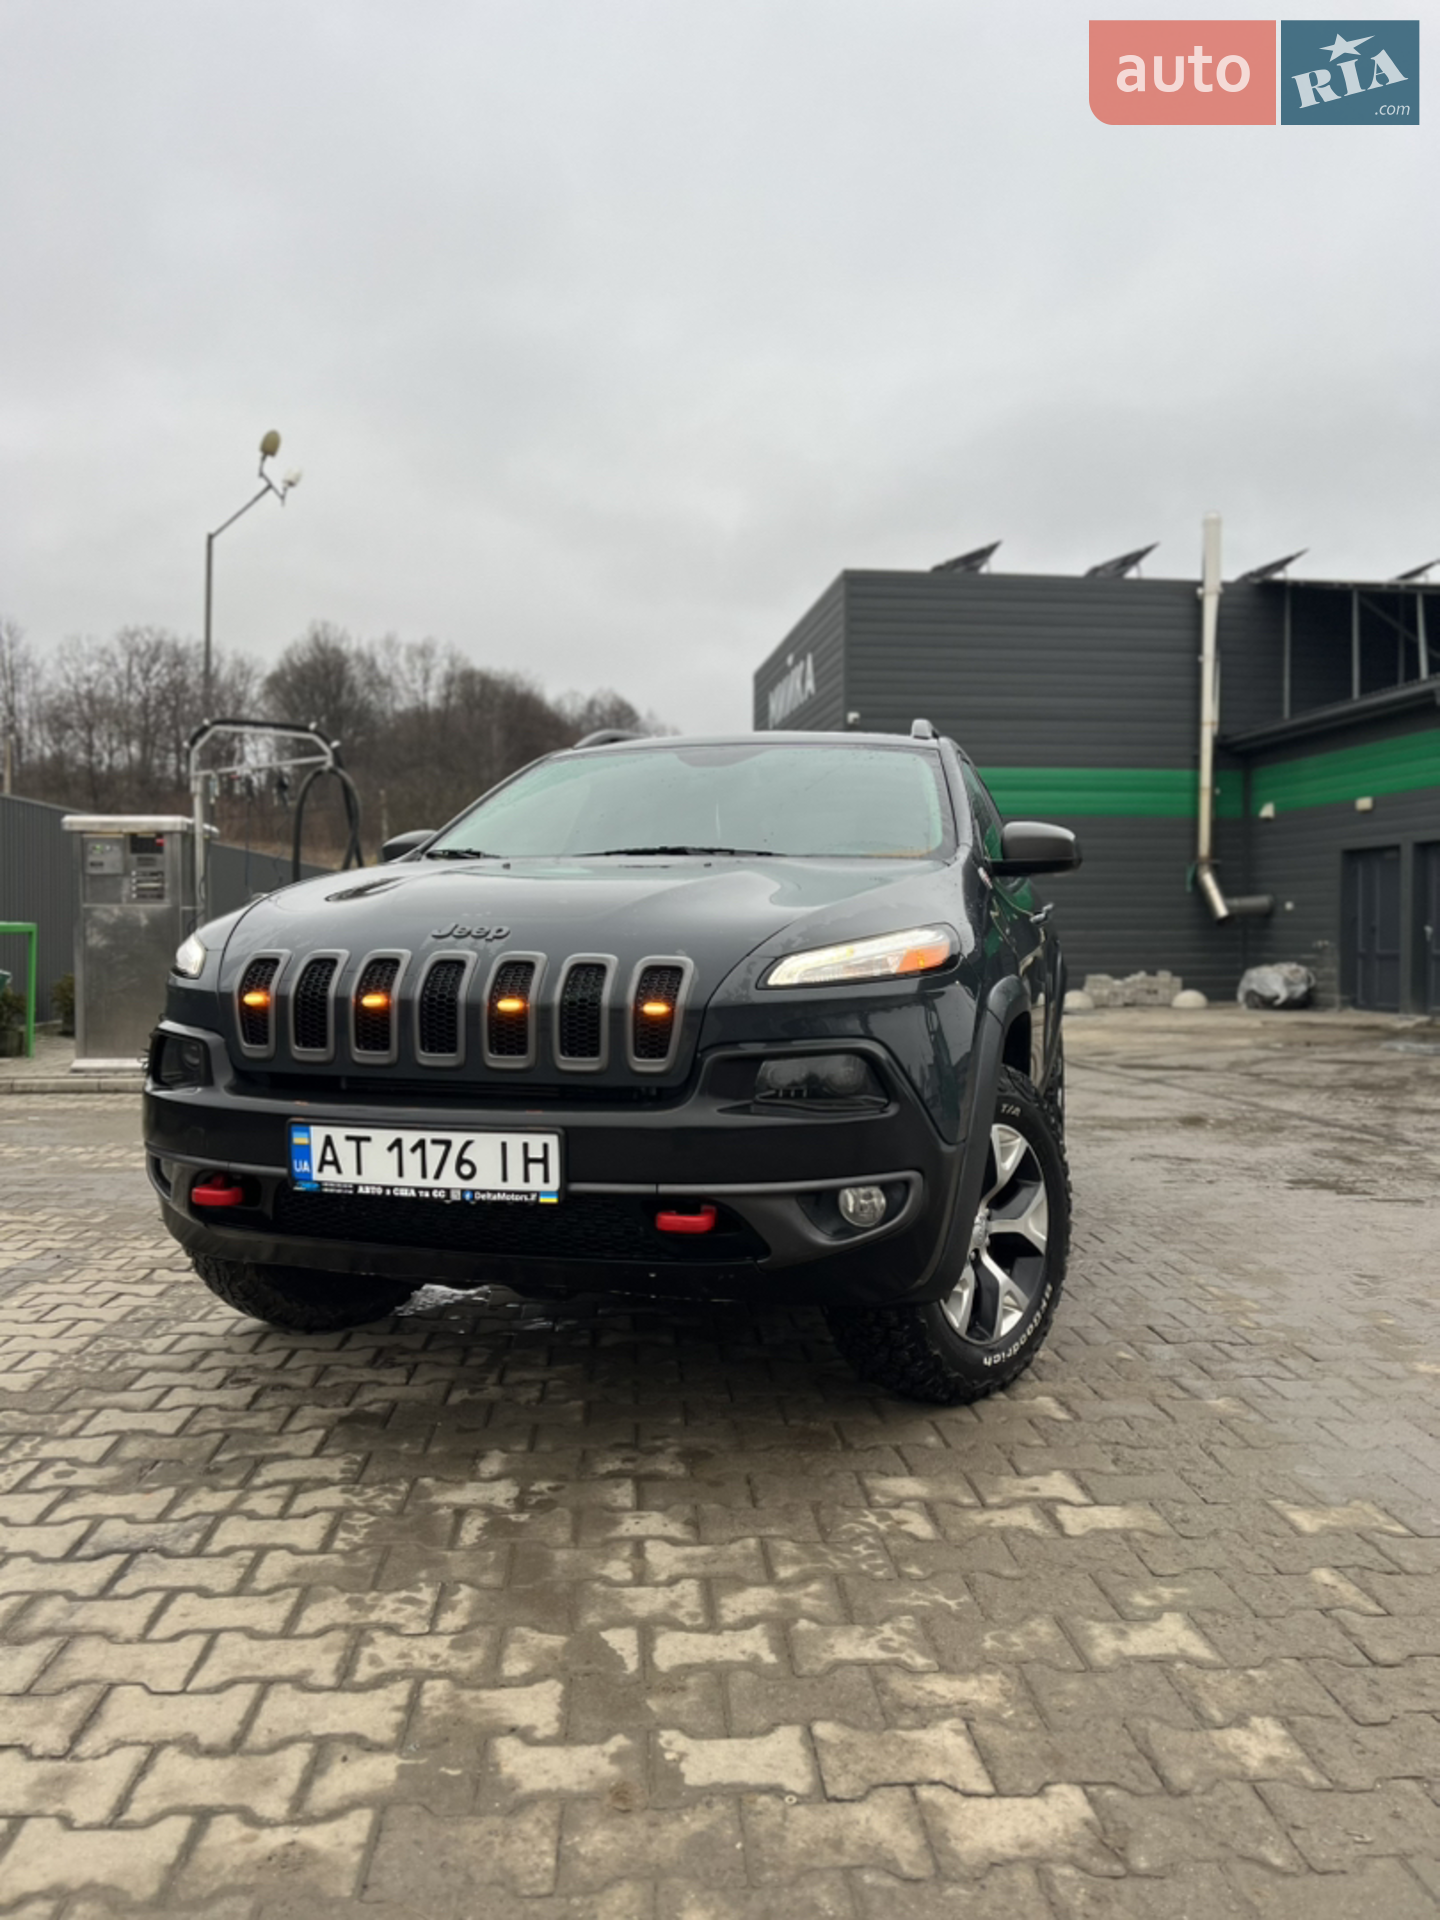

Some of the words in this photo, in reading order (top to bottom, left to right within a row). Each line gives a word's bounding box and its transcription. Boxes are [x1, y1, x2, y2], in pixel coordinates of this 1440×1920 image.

[431, 922, 511, 942] Jeep
[293, 1159, 311, 1173] UA
[317, 1134, 372, 1176] AT
[386, 1137, 477, 1181] 1176
[501, 1141, 550, 1184] IH
[983, 1282, 1053, 1367] BFGoodrich
